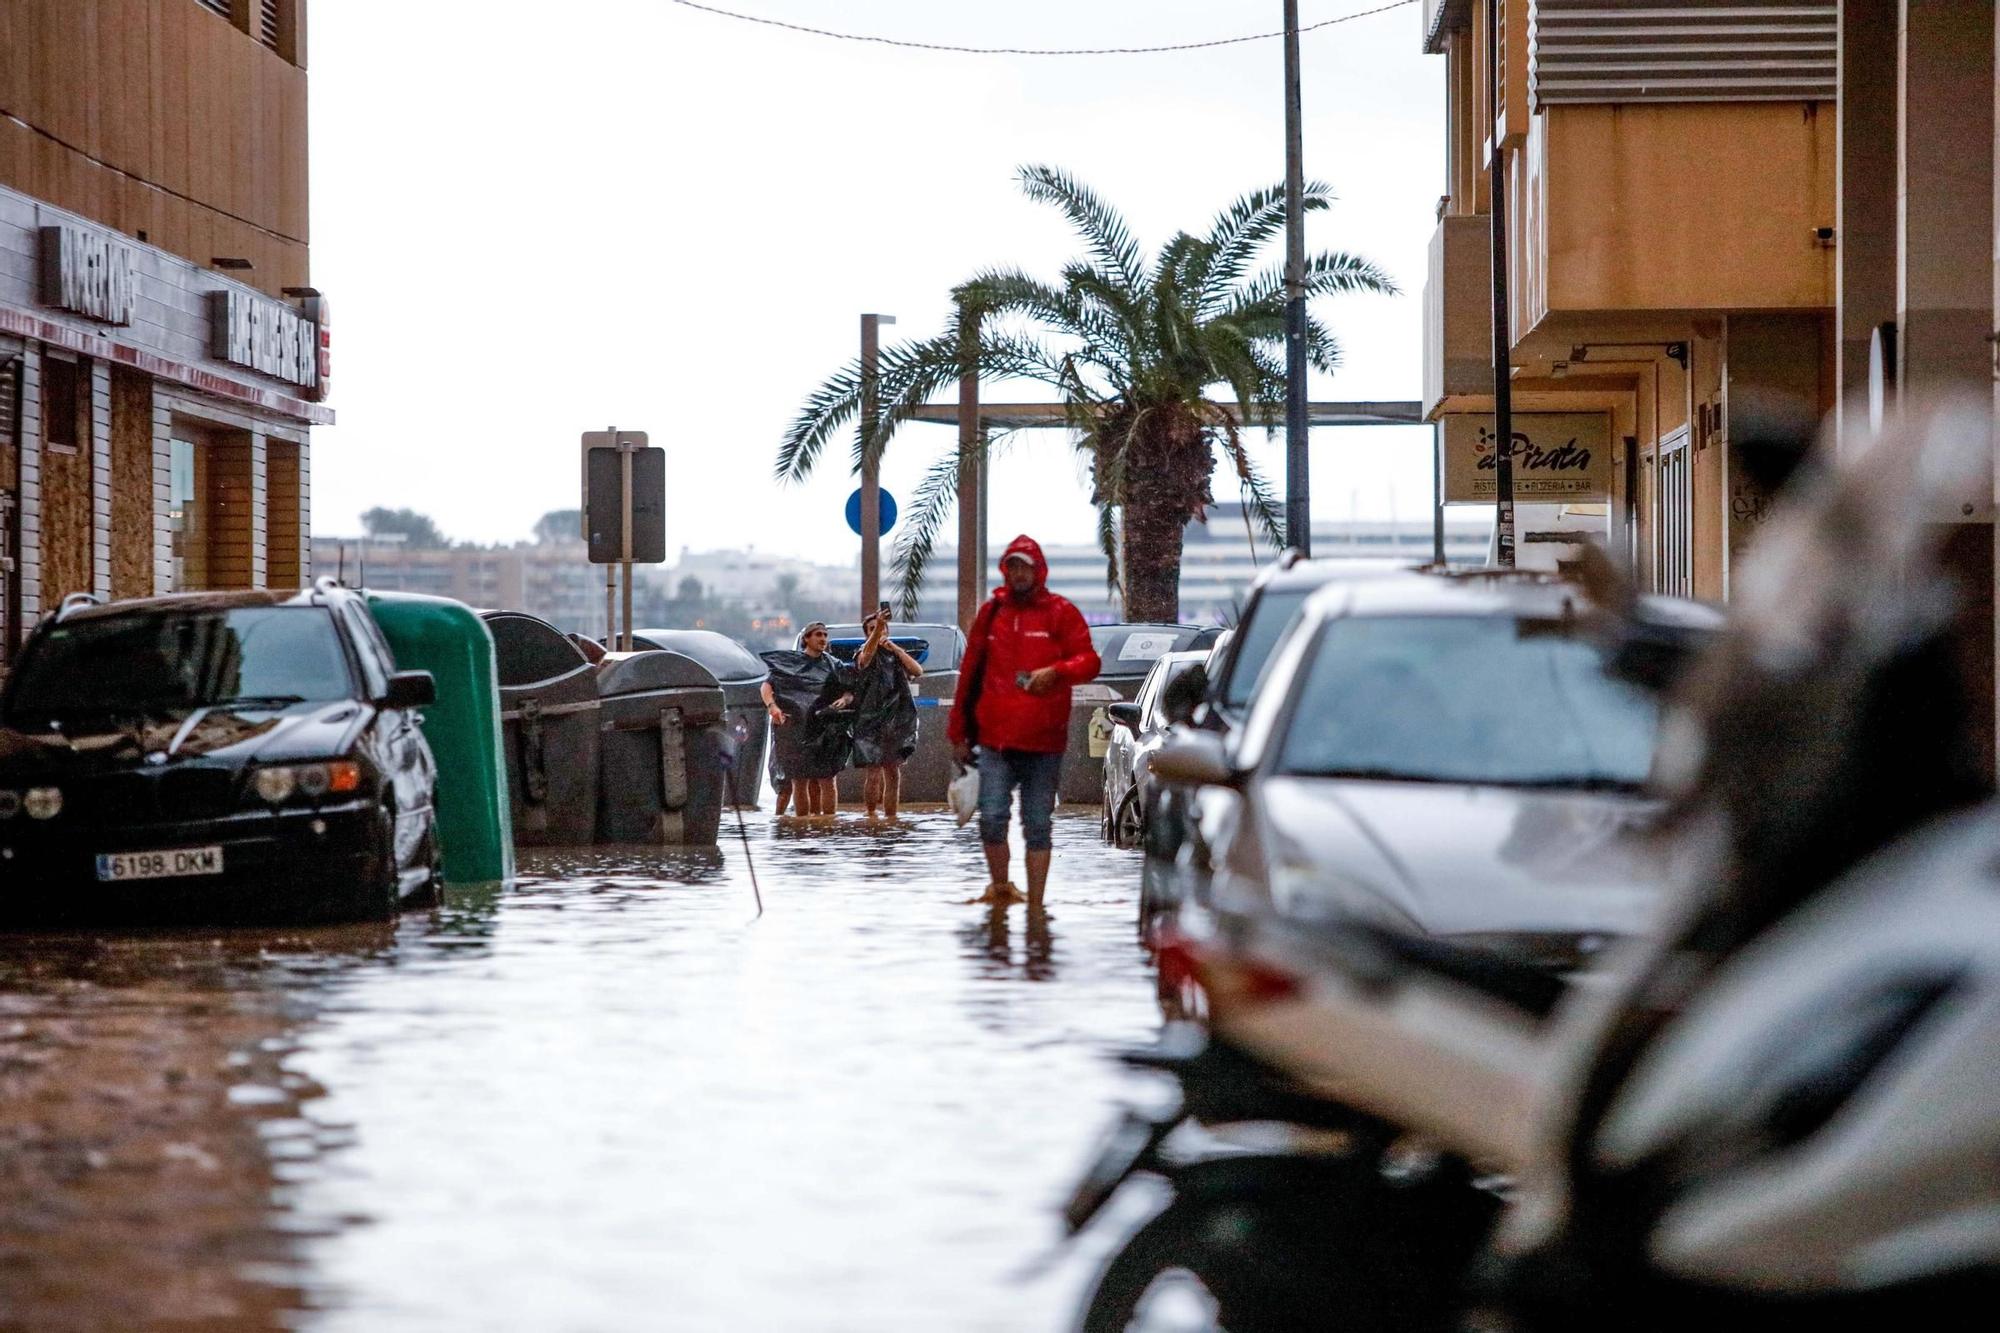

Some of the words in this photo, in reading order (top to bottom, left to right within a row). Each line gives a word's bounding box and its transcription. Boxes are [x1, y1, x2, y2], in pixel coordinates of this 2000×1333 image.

[1511, 432, 1591, 471] Pirata
[1474, 481, 1521, 491] RISTOTE
[1531, 481, 1565, 491] PIZZERIA
[1575, 481, 1591, 491] BAR
[112, 854, 164, 877] 6198
